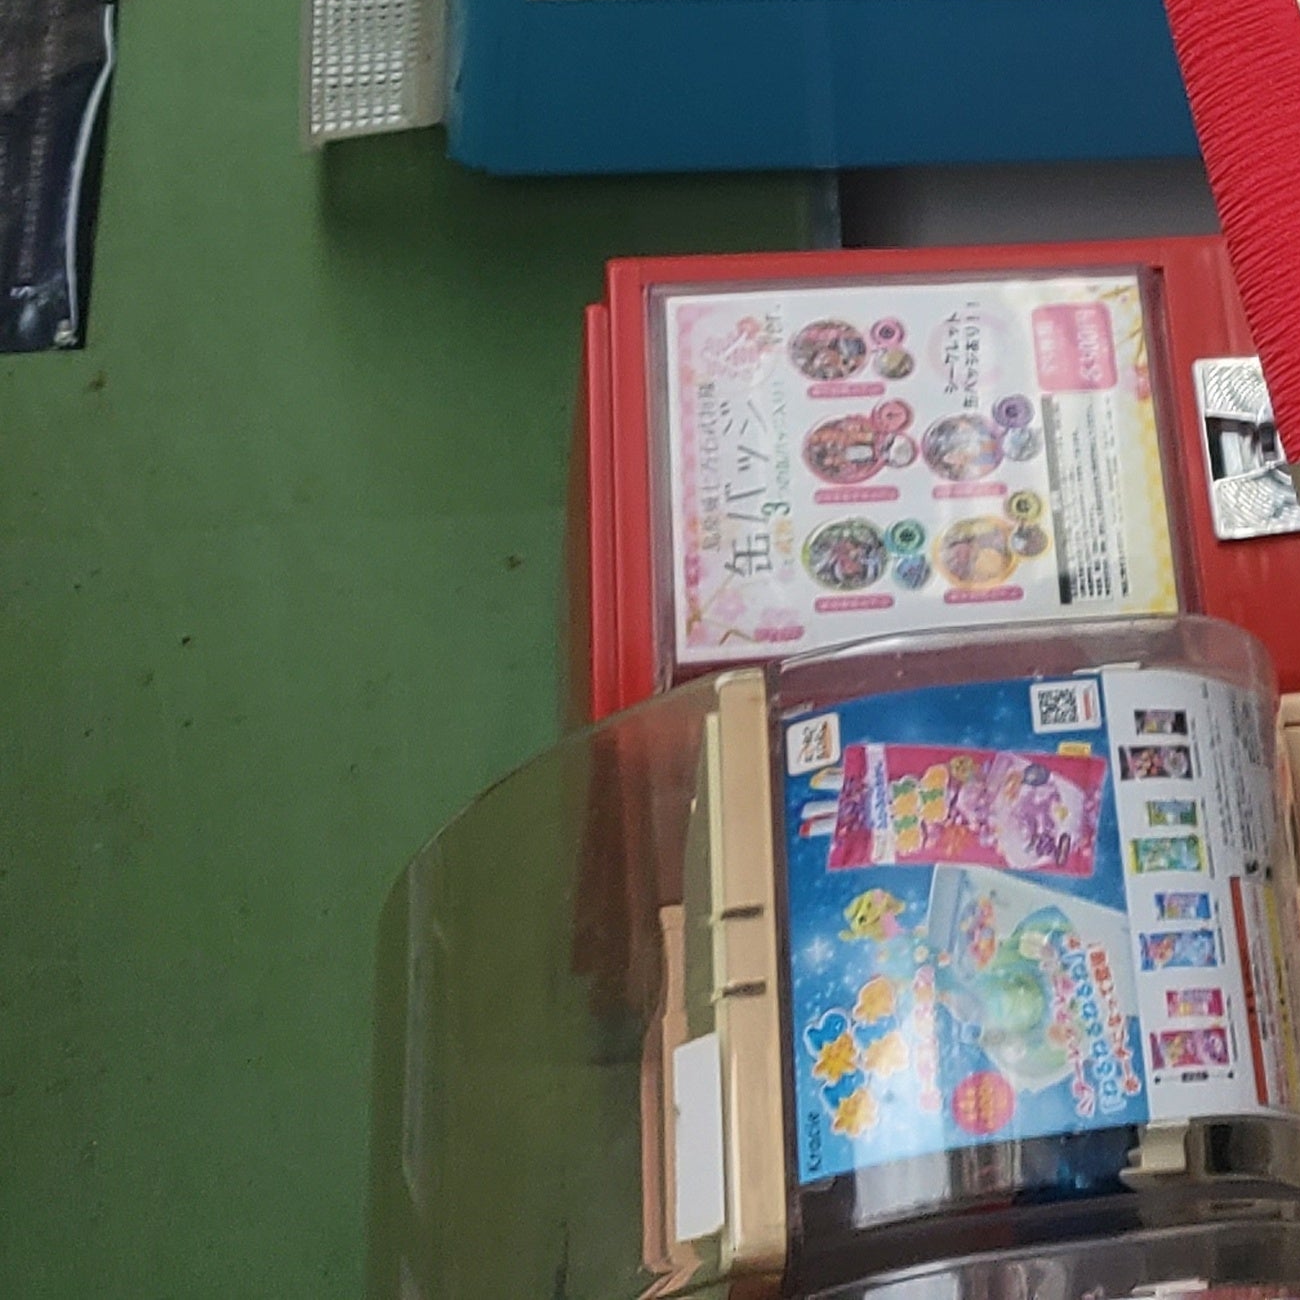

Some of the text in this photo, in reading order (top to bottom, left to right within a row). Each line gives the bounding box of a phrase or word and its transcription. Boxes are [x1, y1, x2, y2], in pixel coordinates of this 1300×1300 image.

[720, 399, 774, 577] 缶バッジ
[806, 1110, 823, 1173] Kracie
